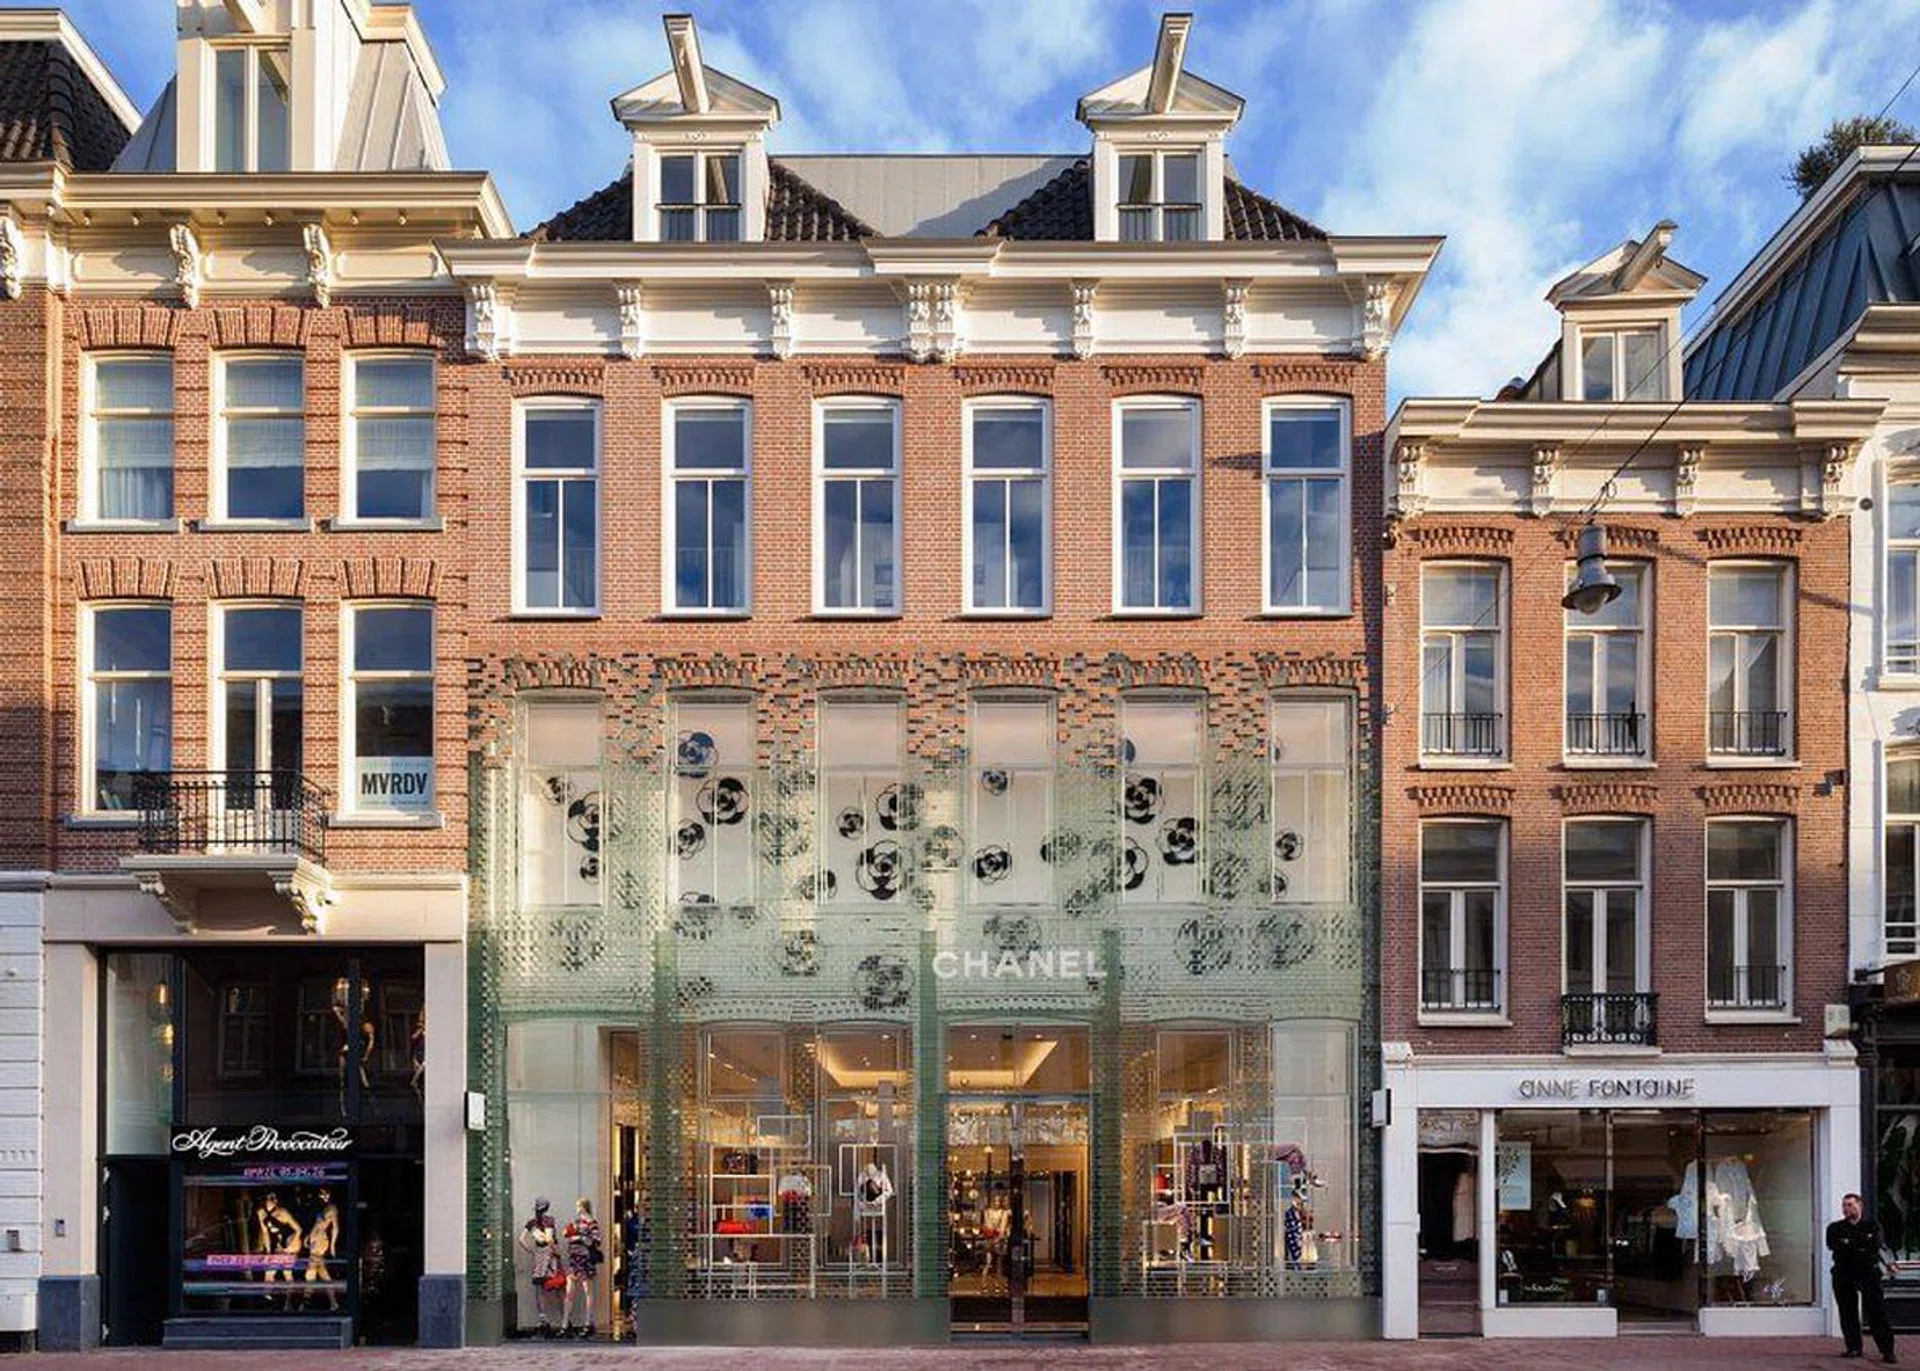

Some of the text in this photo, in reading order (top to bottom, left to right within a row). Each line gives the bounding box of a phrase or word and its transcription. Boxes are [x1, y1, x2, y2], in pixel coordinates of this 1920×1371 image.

[361, 772, 428, 795] MVRDV
[932, 950, 1107, 978] CHANEL
[172, 1125, 352, 1159] Agent Provocateur
